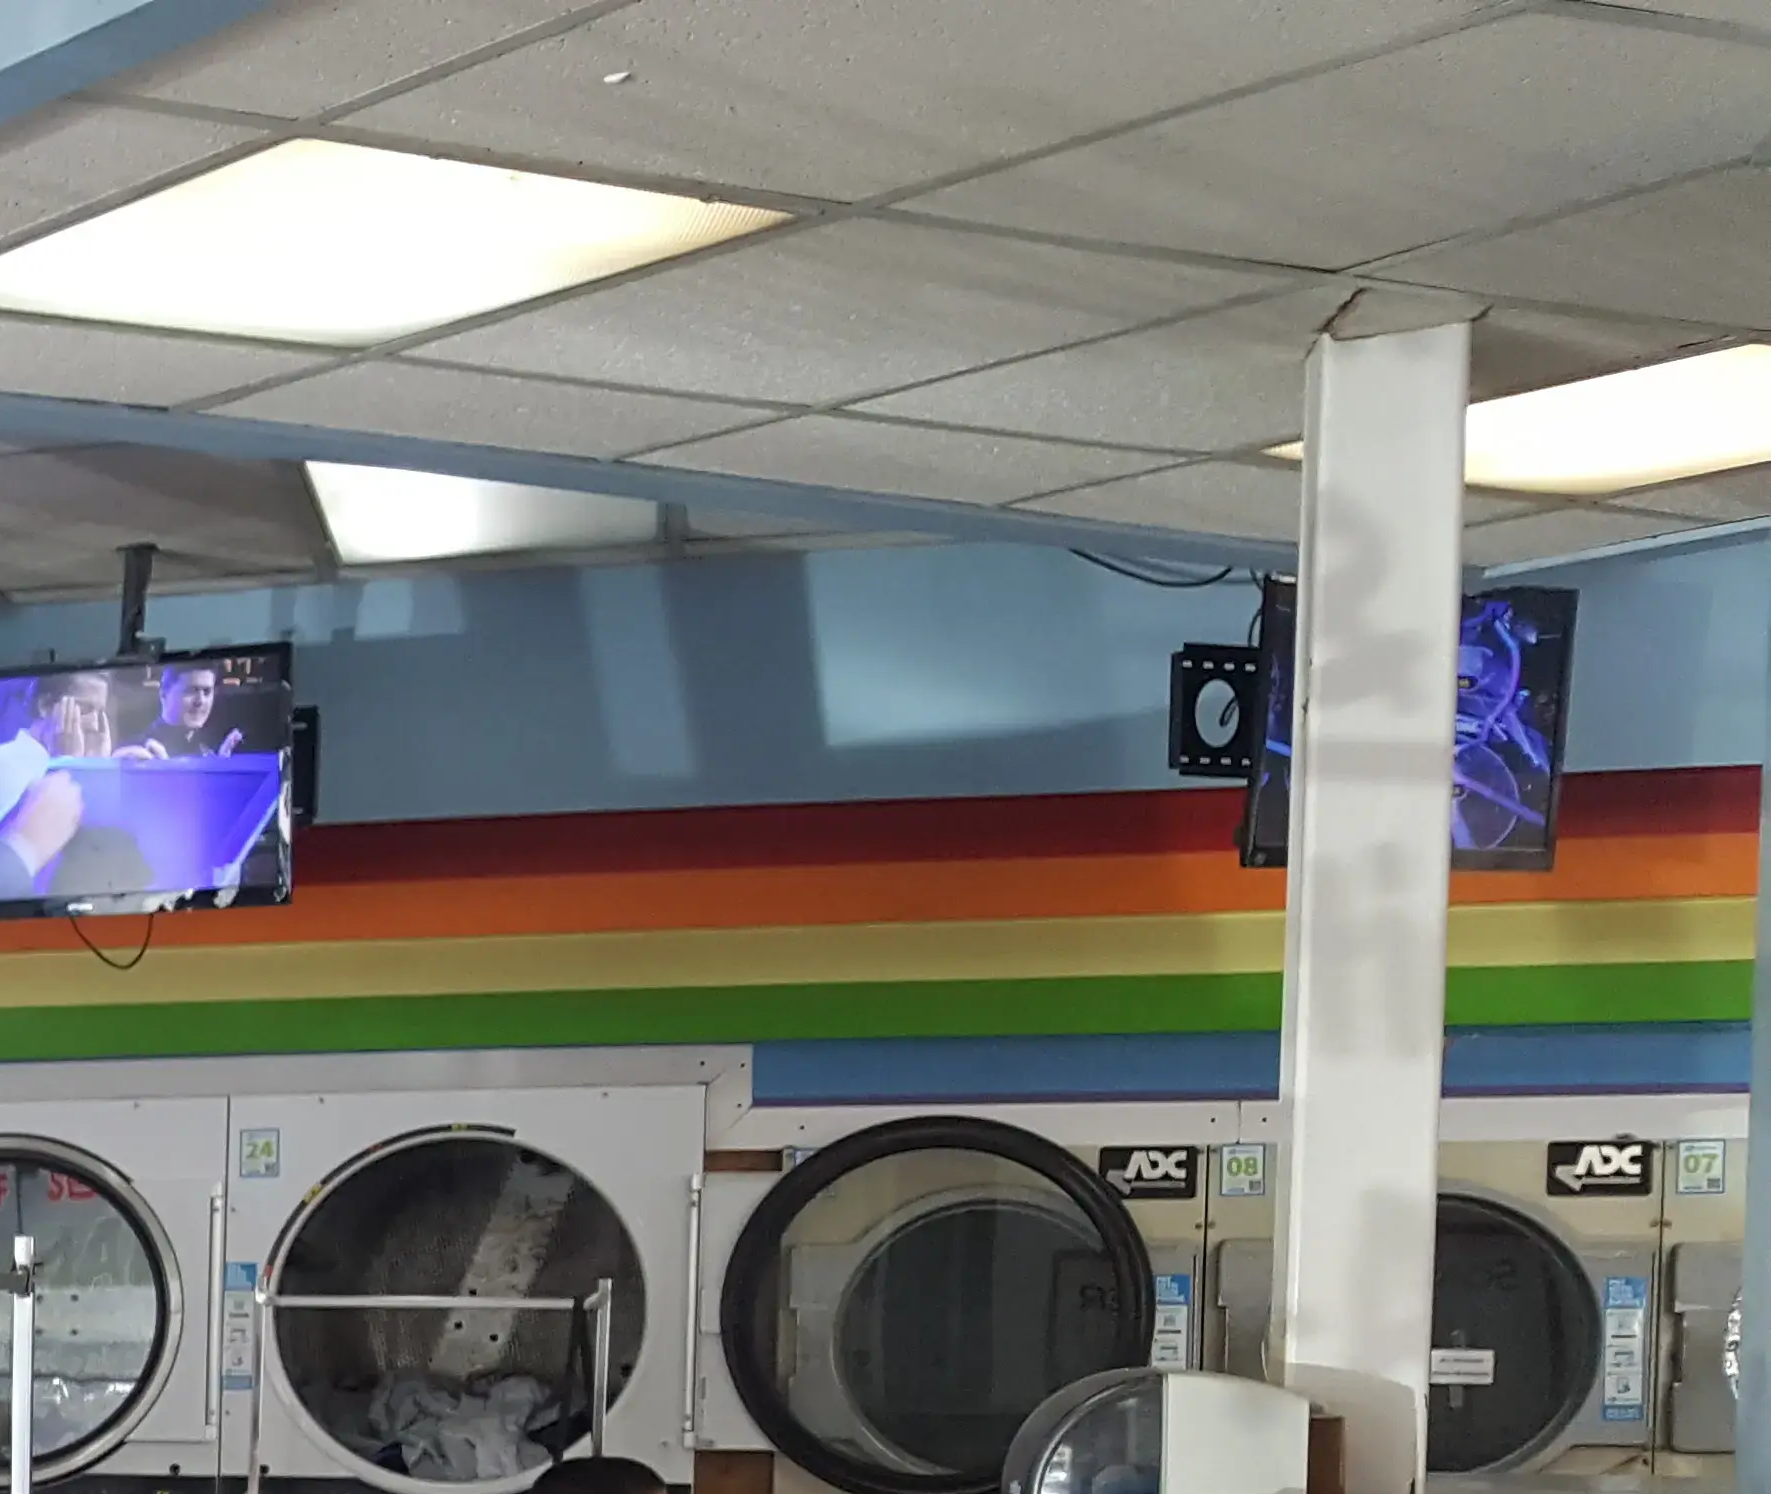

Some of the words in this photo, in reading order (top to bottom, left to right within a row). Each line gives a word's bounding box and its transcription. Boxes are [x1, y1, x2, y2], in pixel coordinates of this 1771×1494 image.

[245, 1139, 274, 1158] 24
[1124, 1150, 1188, 1180] ADC
[1227, 1156, 1258, 1177] 08
[1574, 1145, 1643, 1176] ADC
[1683, 1153, 1719, 1174] 07
